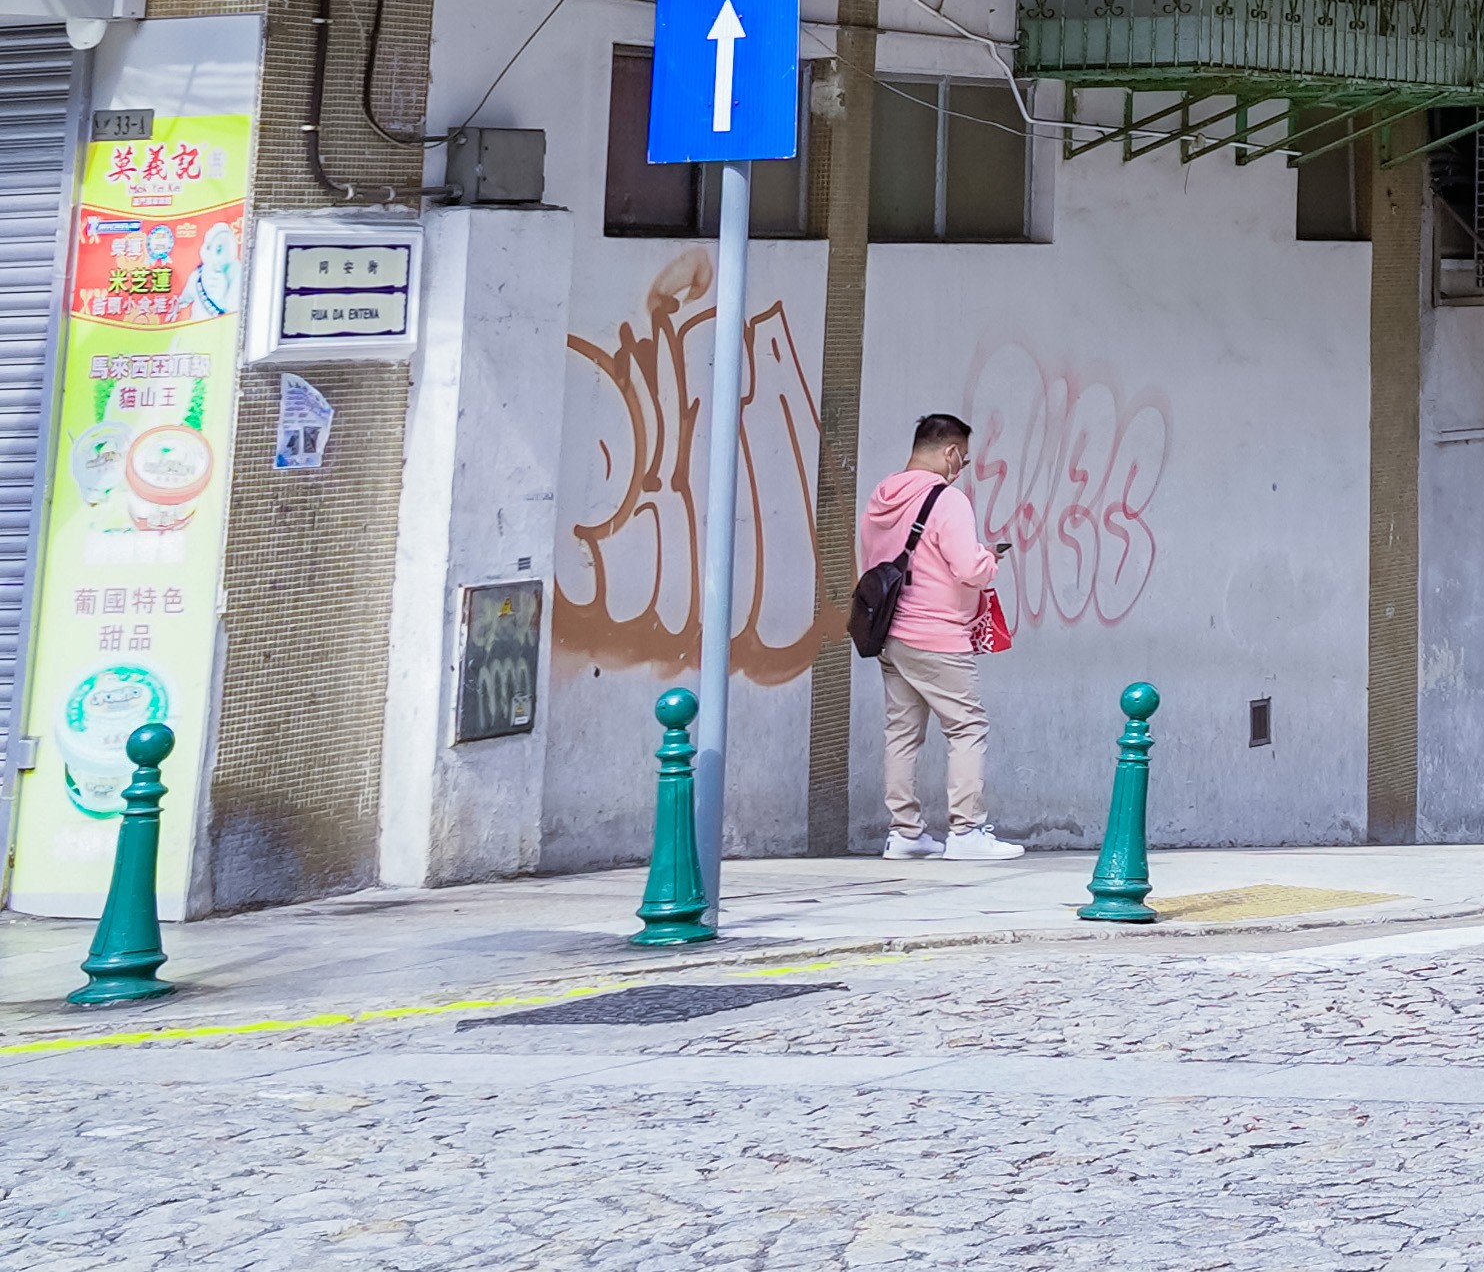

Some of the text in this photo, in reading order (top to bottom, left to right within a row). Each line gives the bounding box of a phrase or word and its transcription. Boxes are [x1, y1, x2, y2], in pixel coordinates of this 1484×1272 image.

[107, 143, 201, 182] 莫義記
[107, 266, 172, 294] 米芝蓮
[310, 307, 380, 322] RUA DA ENTENA
[118, 386, 177, 409] 貓山王
[74, 587, 185, 615] 葡國特色
[99, 625, 151, 651] 甜品
